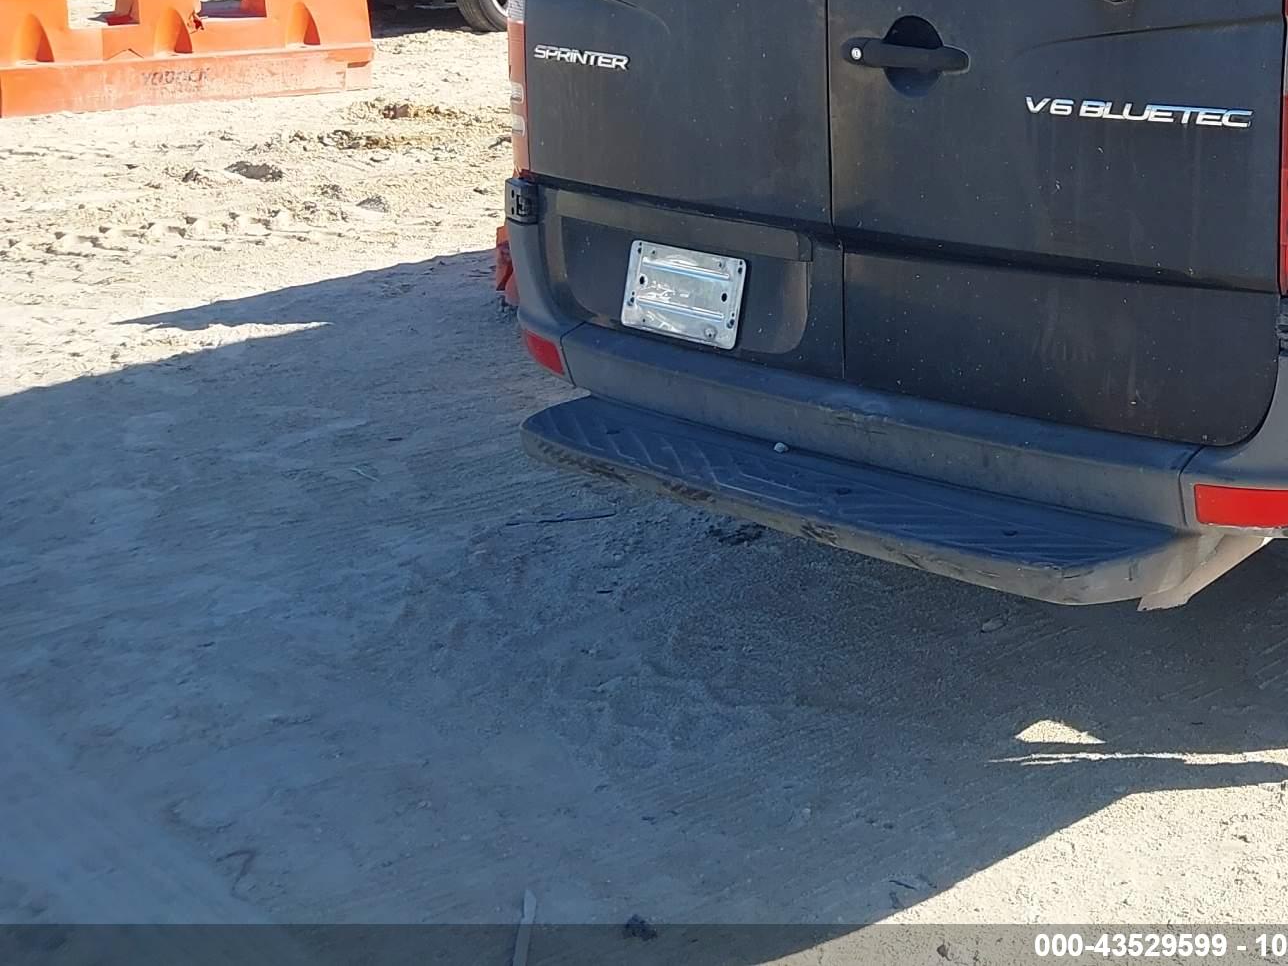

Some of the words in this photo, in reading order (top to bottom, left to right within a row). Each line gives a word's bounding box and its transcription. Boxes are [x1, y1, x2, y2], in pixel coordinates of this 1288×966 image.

[534, 44, 629, 71] SPRINTER
[1025, 96, 1074, 115] V6
[1079, 99, 1253, 128] BLUETEC
